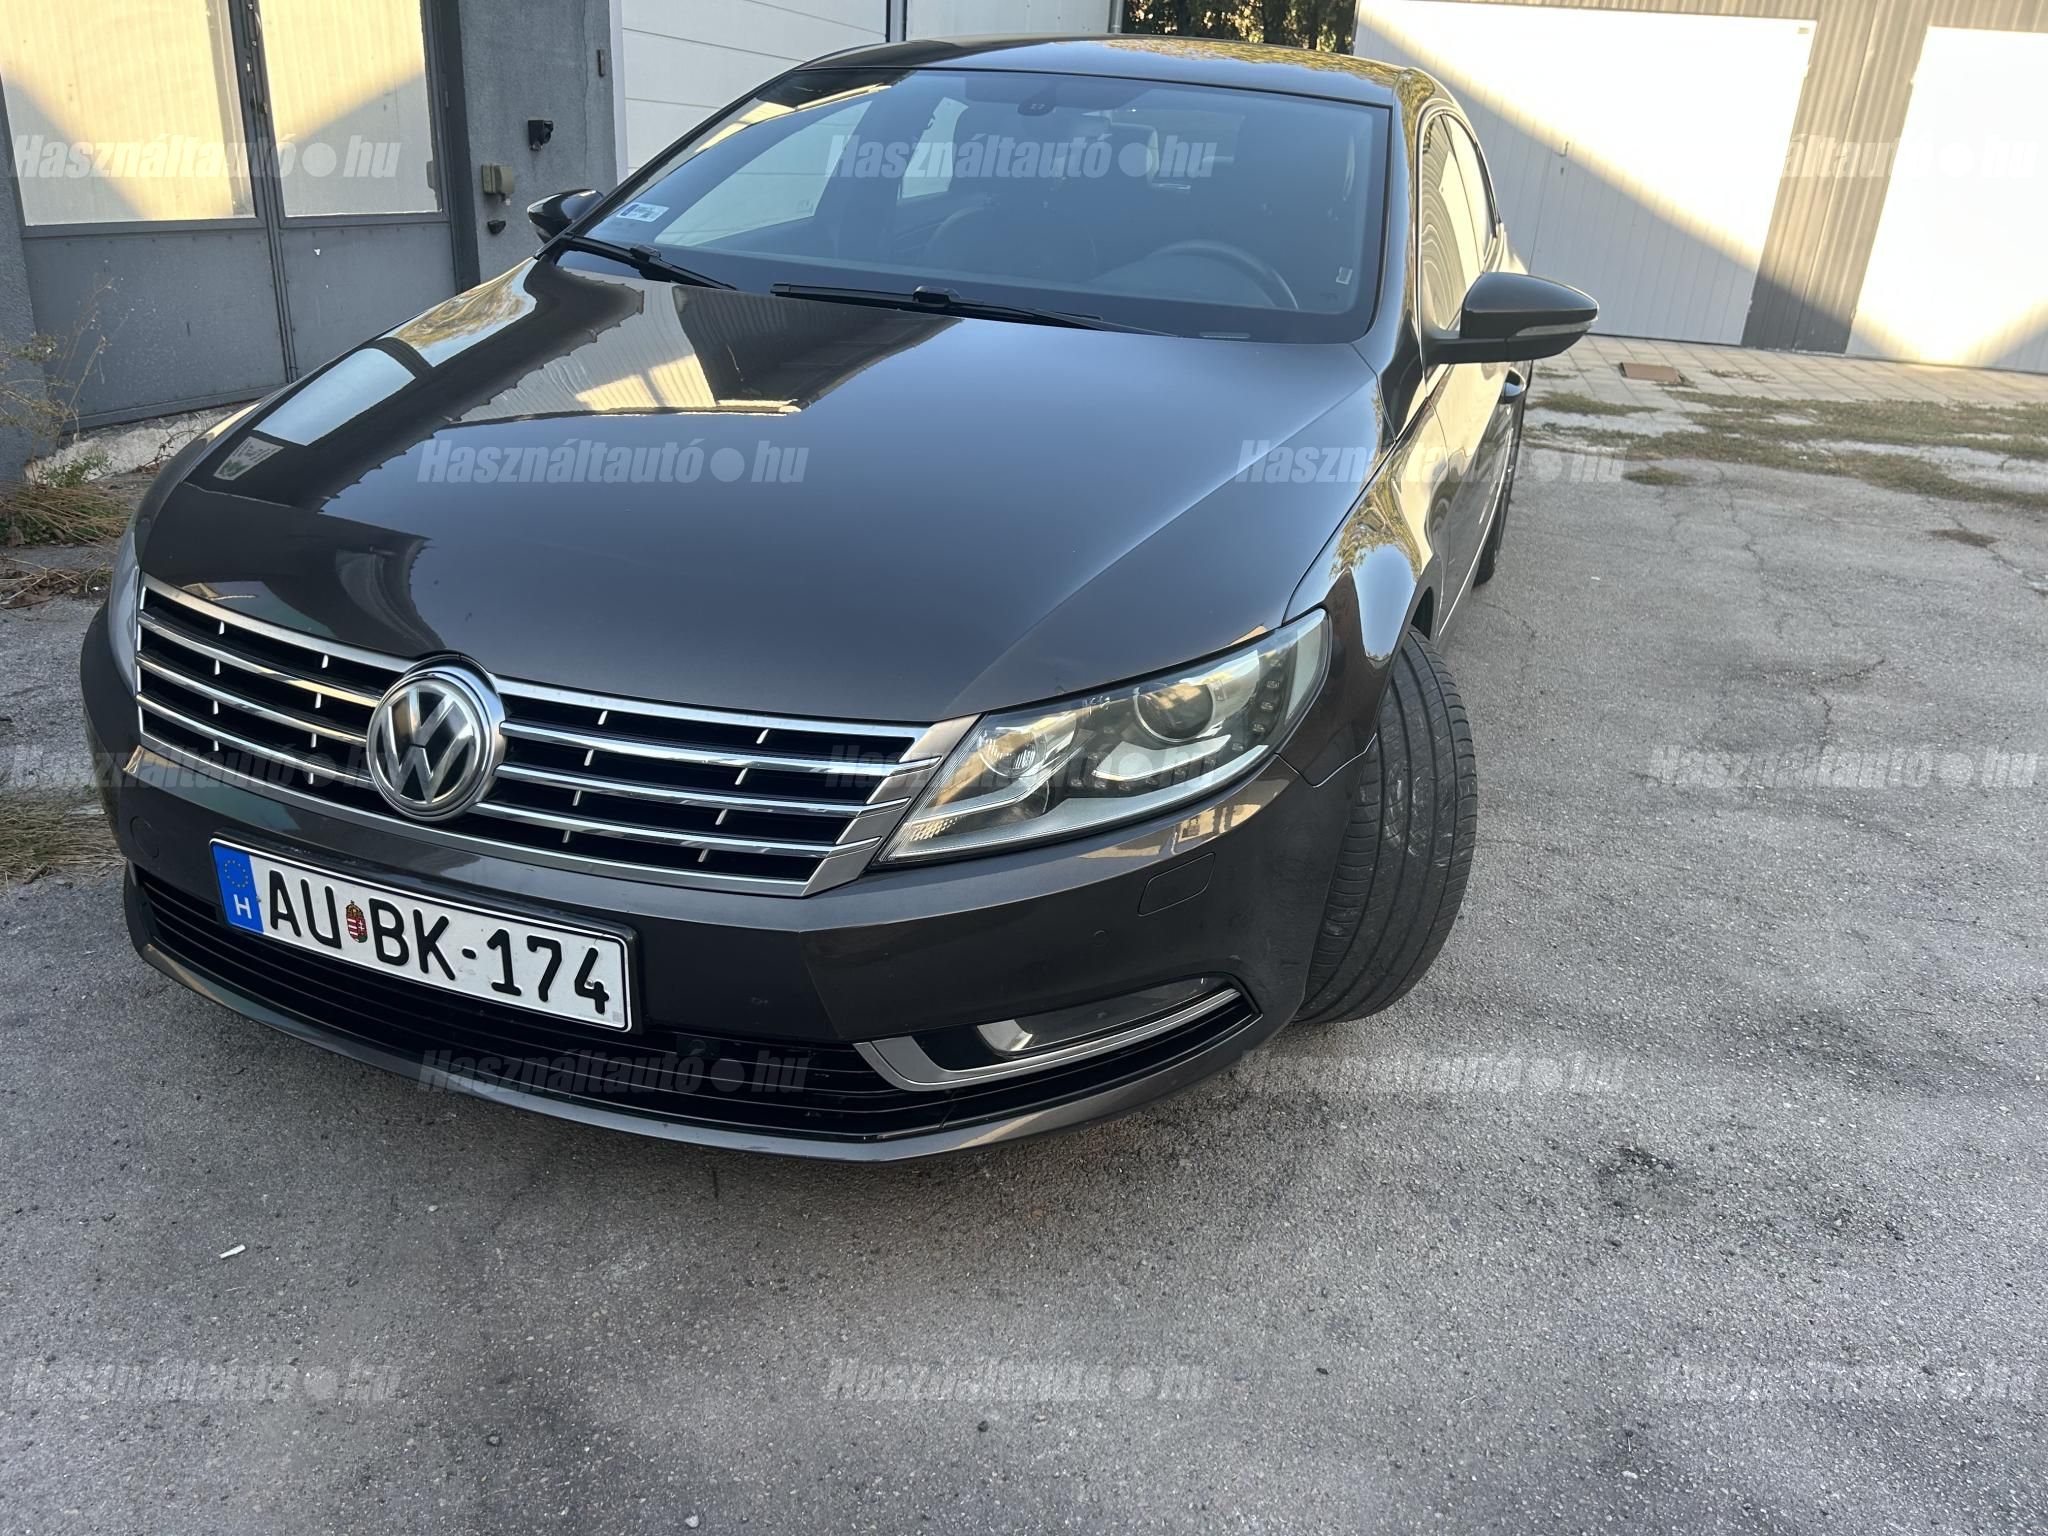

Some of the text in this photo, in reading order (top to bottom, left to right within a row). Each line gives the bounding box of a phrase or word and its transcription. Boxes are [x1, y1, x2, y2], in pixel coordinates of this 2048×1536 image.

[232, 893, 254, 921] H
[268, 869, 611, 1016] AU BK-174
